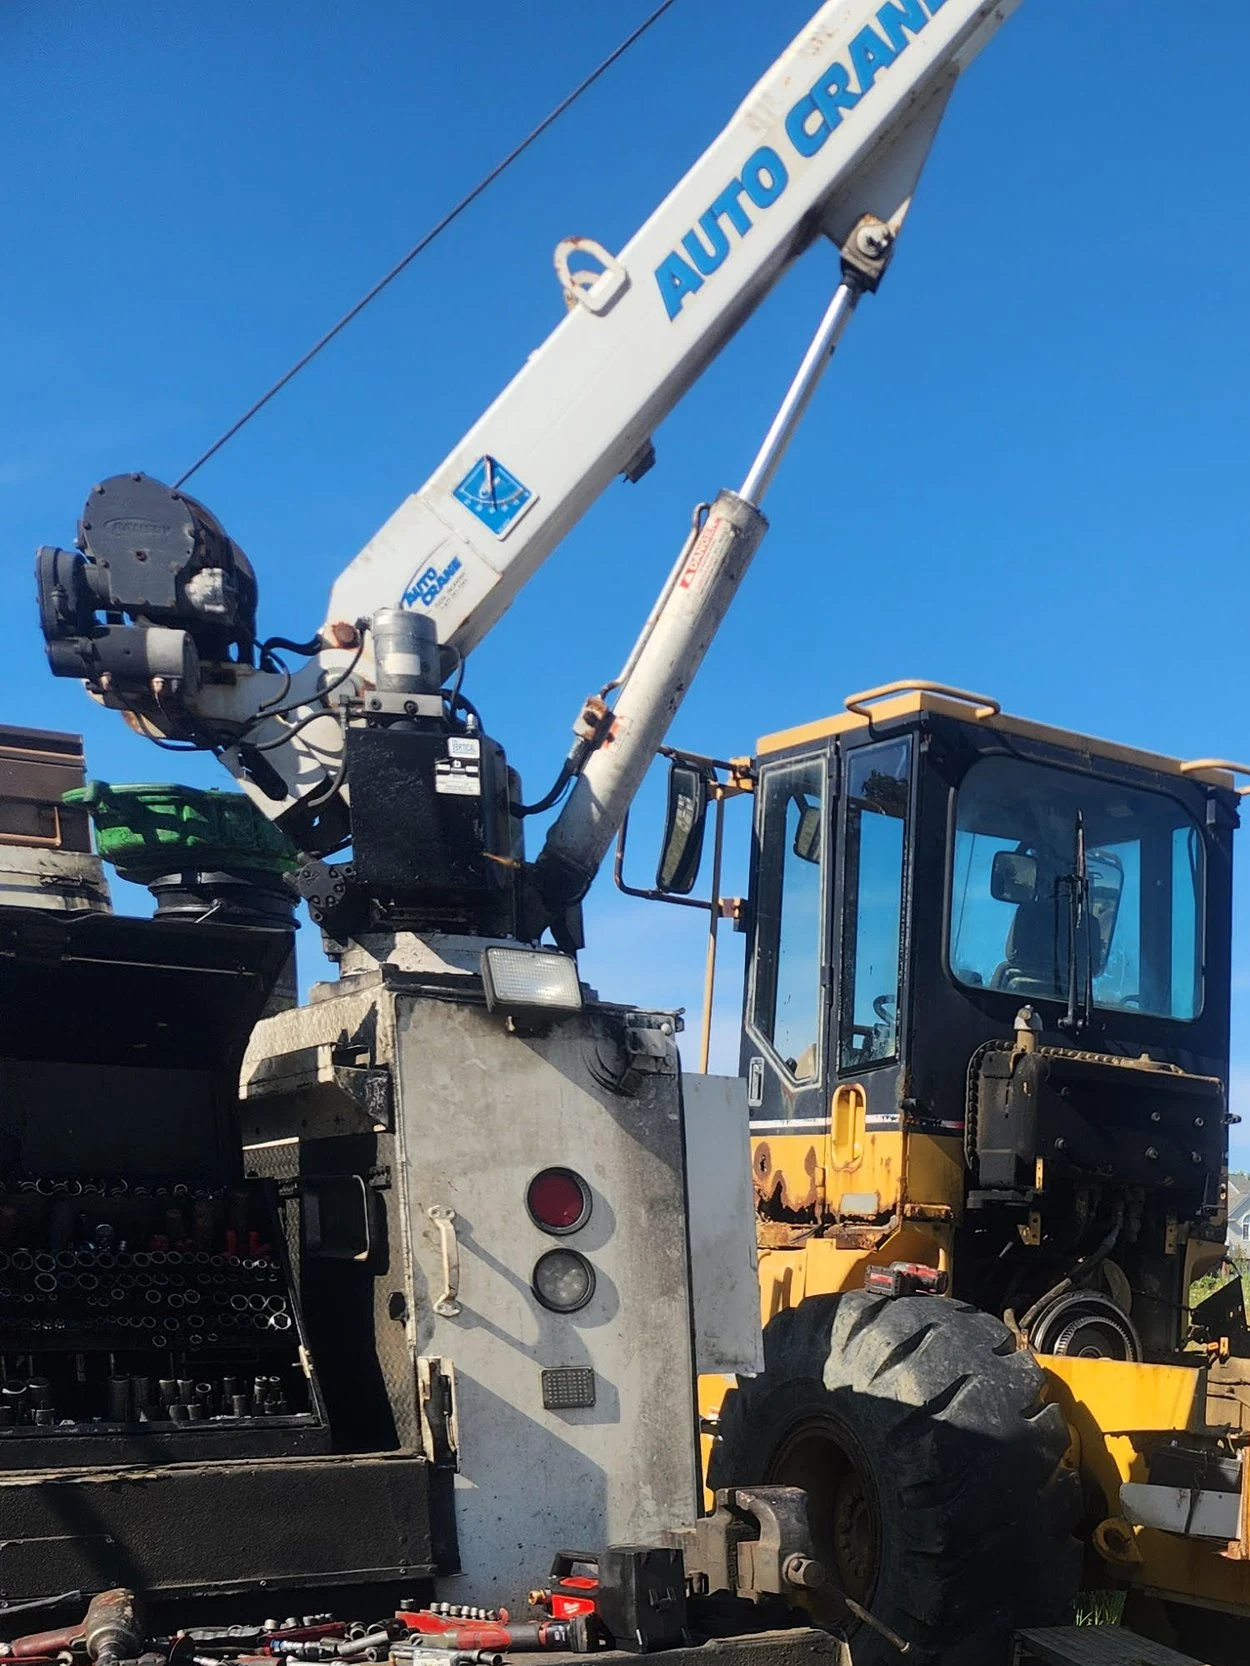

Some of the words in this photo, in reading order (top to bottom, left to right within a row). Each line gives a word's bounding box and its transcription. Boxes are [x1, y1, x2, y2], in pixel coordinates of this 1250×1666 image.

[654, 146, 788, 322] AUTO
[785, 0, 947, 158] CRAN
[405, 566, 438, 607] AUTO
[421, 555, 463, 606] CRANE
